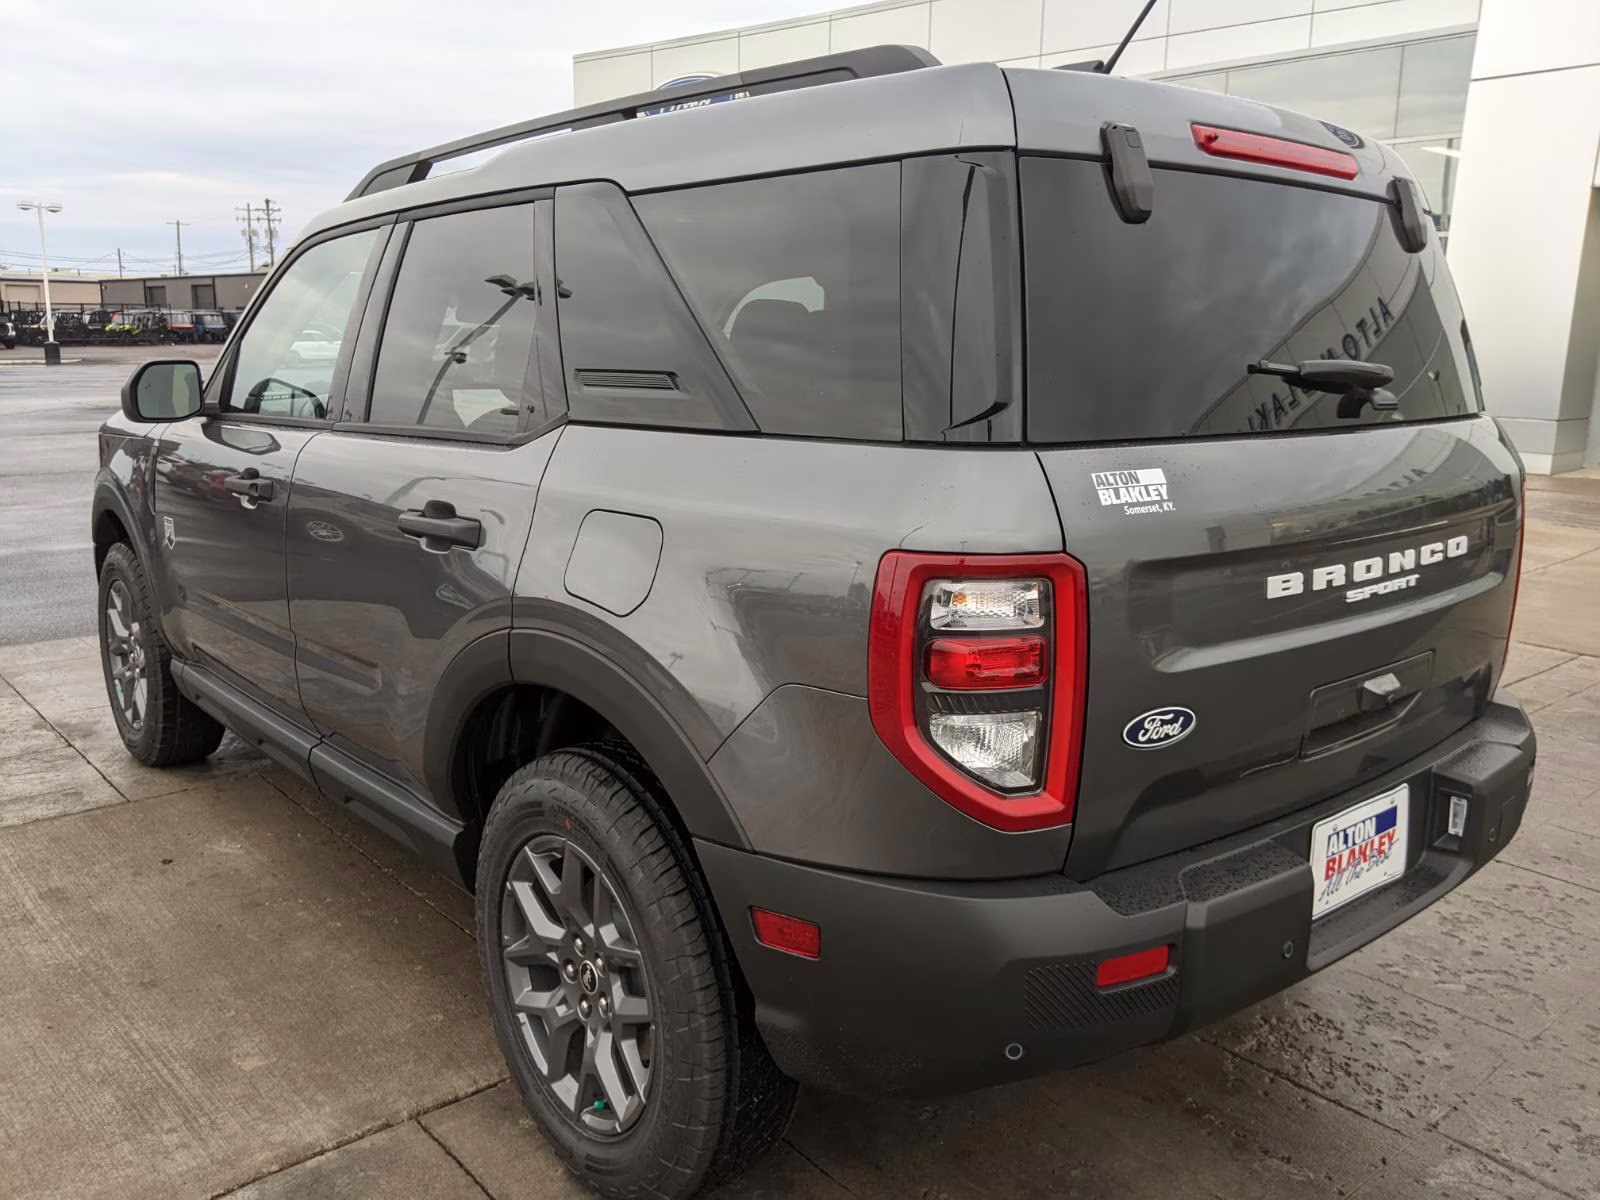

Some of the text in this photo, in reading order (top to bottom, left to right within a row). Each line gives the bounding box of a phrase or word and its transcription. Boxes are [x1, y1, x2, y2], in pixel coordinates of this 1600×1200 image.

[1095, 471, 1140, 488] ALTON
[1098, 484, 1168, 506] BLAKLEY
[1124, 503, 1163, 515] Somerset,
[1267, 535, 1468, 599] BRONCO
[1345, 574, 1420, 603] SPORT
[1138, 713, 1184, 742] Ford
[1328, 816, 1376, 856] ALTON
[1324, 829, 1397, 881] BLAKLEY
